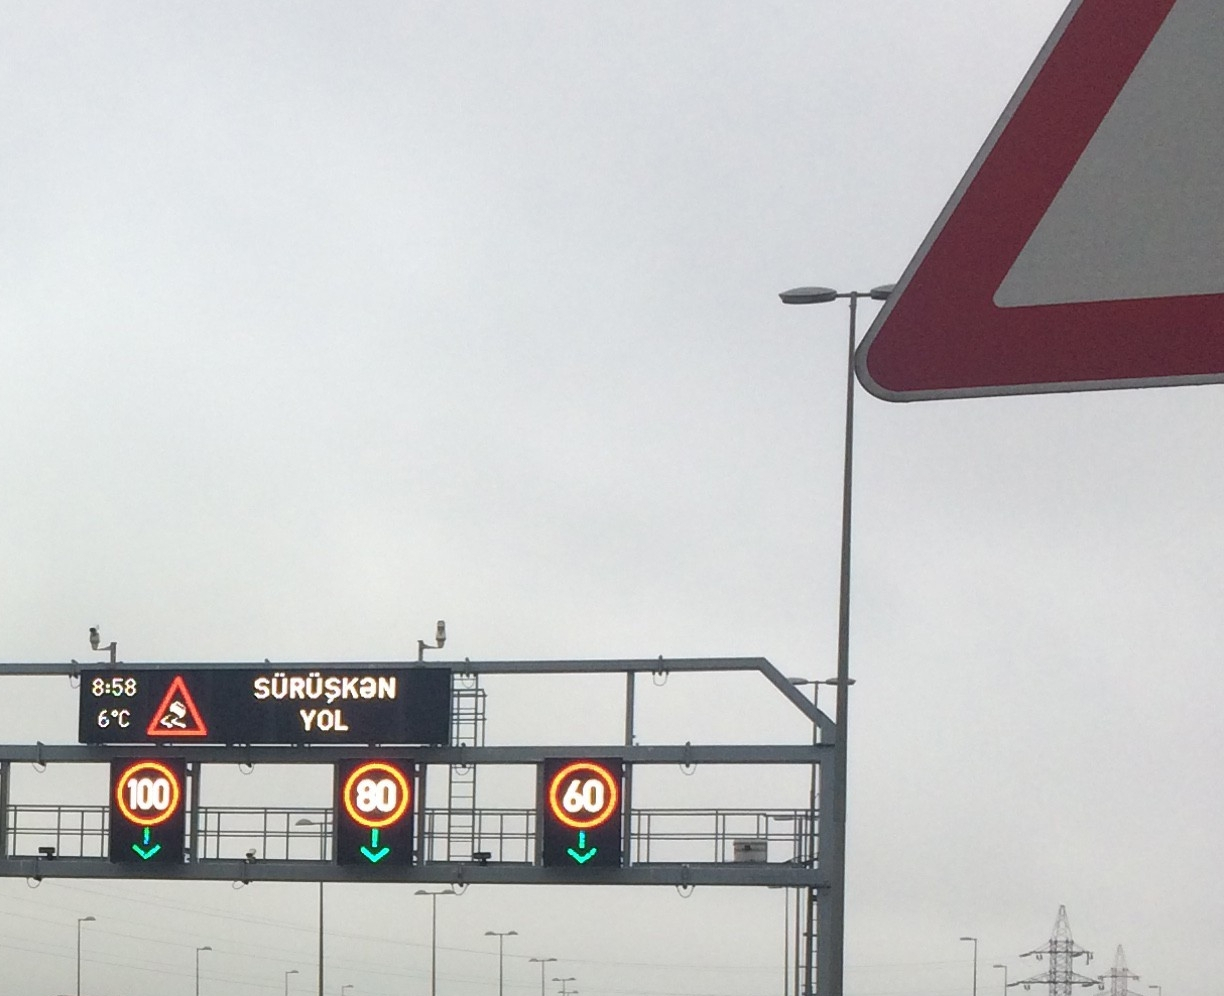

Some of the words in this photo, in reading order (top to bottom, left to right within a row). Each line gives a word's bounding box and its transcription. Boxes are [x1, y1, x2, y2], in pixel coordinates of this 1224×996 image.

[92, 677, 137, 697] 8:58
[253, 672, 397, 704] SÜRÜŞKƏN
[97, 709, 131, 728] 6°C
[299, 709, 349, 731] YOL
[127, 777, 170, 811] 100
[356, 778, 397, 813] 80
[562, 778, 605, 813] 60
